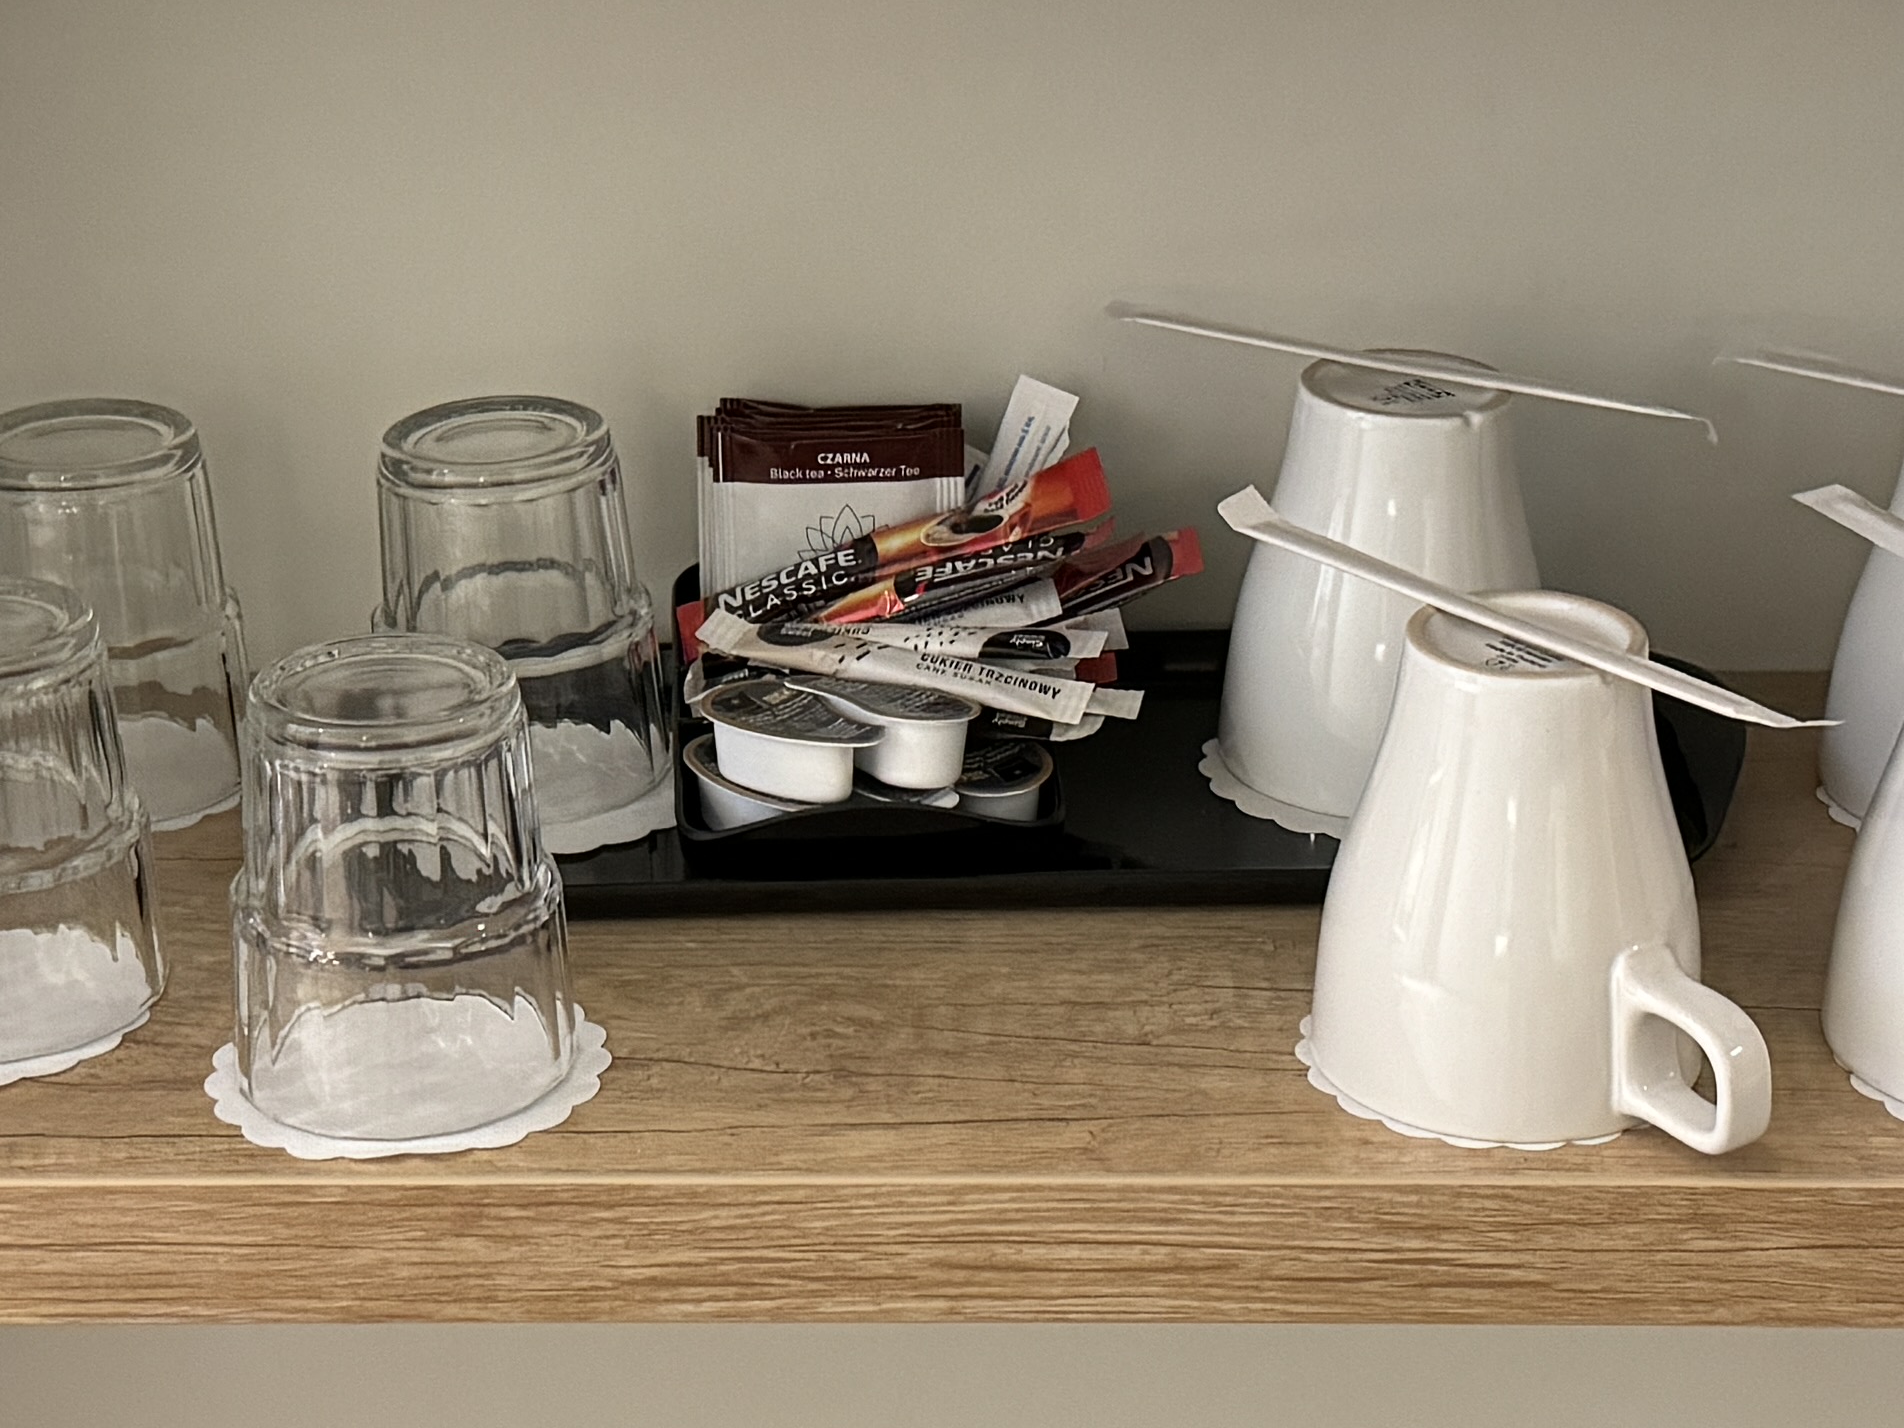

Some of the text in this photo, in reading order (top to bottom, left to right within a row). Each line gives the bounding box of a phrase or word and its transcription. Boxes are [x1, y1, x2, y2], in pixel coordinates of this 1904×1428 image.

[817, 452, 870, 465] CZARNA
[770, 467, 803, 480] Black
[805, 468, 825, 479] tea
[834, 466, 897, 479] Schwarzer
[978, 666, 1062, 700] TRZCINOWY
